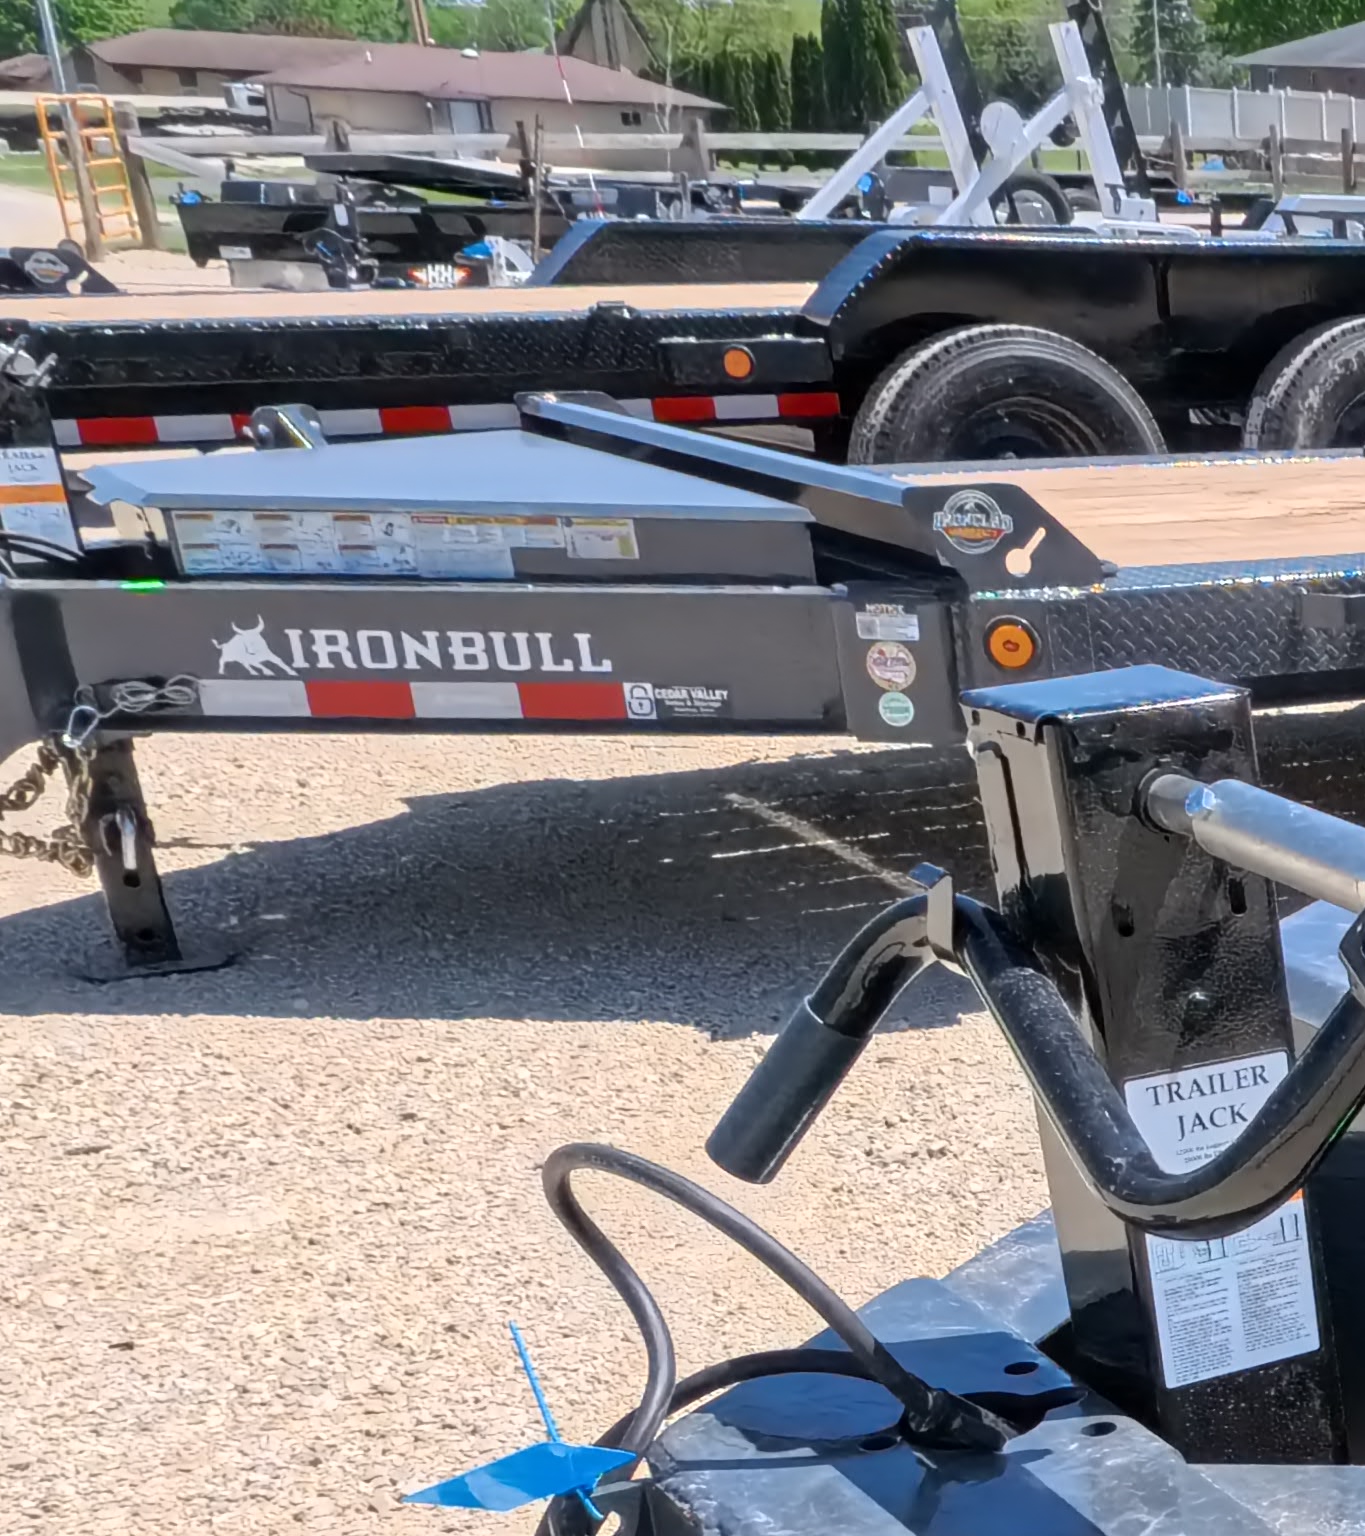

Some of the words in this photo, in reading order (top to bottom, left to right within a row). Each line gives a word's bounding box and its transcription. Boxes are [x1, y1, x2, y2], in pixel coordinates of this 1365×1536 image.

[284, 628, 613, 673] IRONBULL
[1146, 1064, 1270, 1107] TRAILER
[1177, 1102, 1250, 1142] JACK
